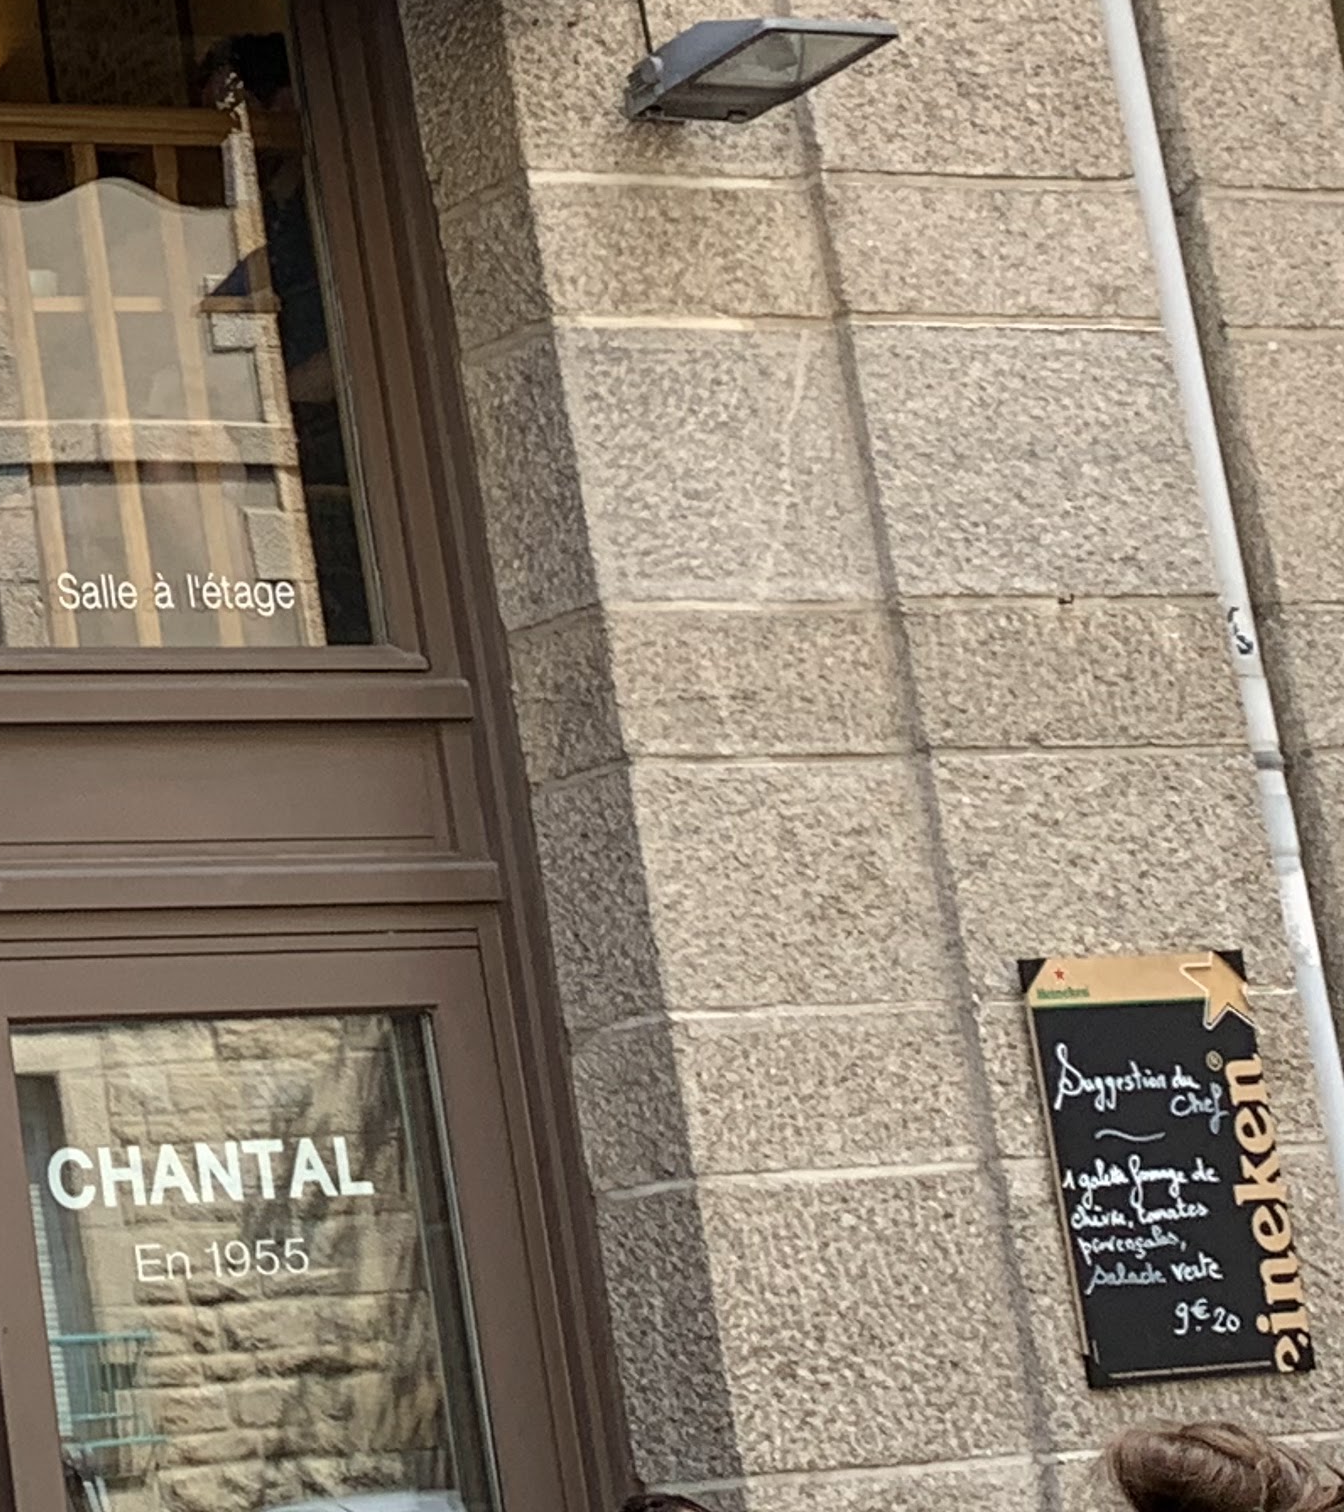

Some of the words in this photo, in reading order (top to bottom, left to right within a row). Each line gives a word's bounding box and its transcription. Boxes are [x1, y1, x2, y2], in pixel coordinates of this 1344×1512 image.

[57, 572, 138, 609] Salle
[153, 572, 175, 609] à
[187, 572, 295, 616] l'étage
[1053, 1042, 1167, 1112] Suggestion
[1171, 1065, 1201, 1090] du
[48, 1136, 375, 1210] CHANTAL
[1191, 1157, 1221, 1183] de
[1137, 1197, 1209, 1226] tomates
[135, 1242, 193, 1282] En
[205, 1238, 310, 1279] 1955
[1084, 1262, 1167, 1296] salade
[1171, 1251, 1224, 1281] verte
